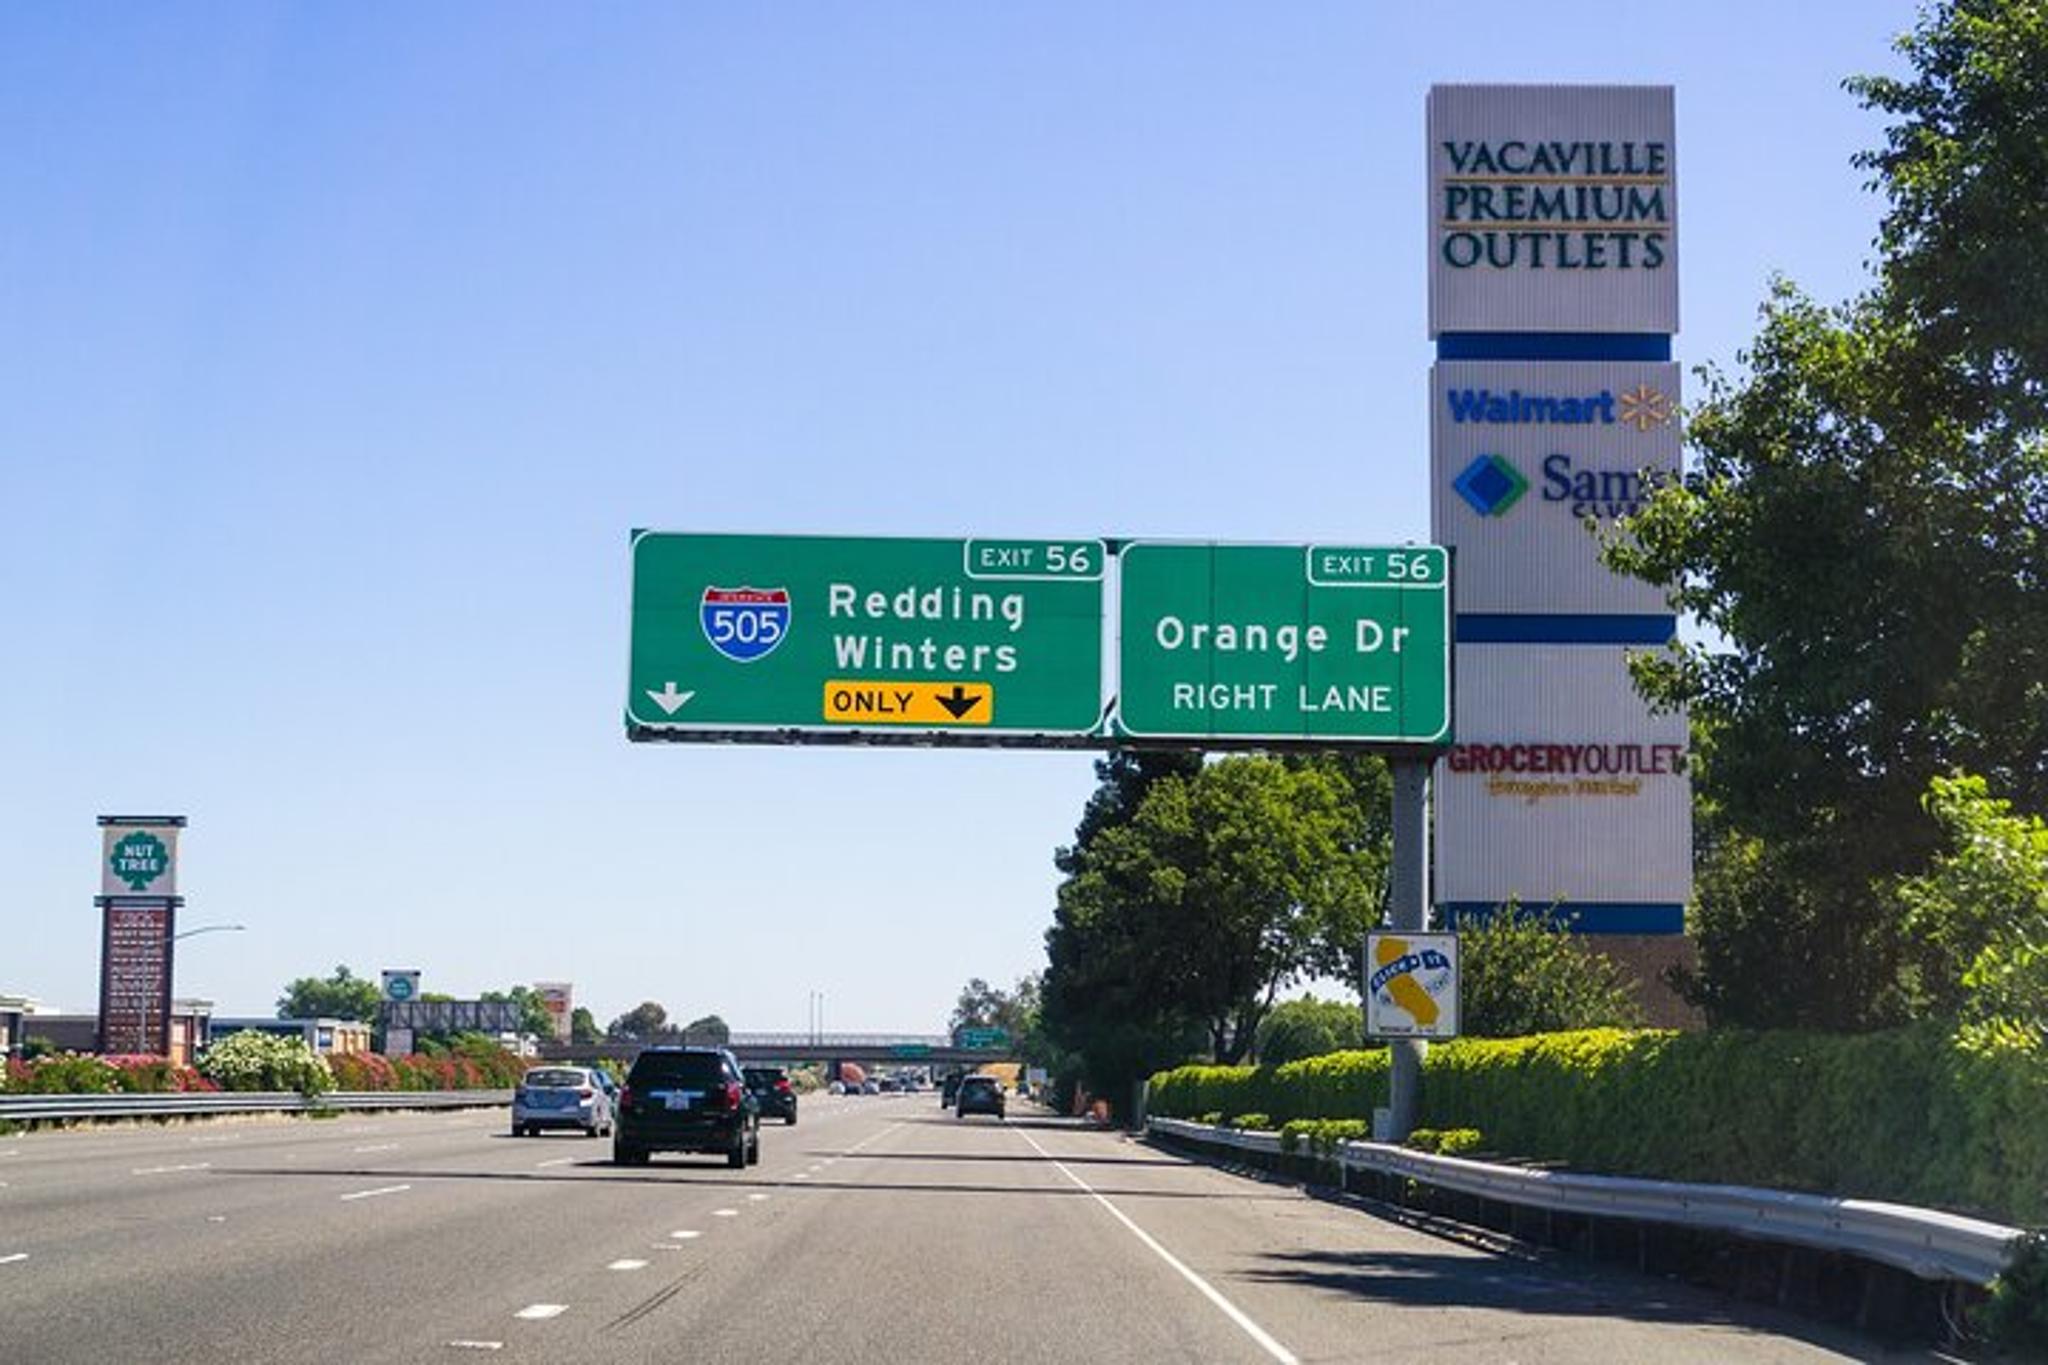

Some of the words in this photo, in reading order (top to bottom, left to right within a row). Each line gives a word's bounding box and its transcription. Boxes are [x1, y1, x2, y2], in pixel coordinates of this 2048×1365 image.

[1443, 141, 1666, 175] VACAVILLE
[1444, 186, 1667, 222] PREMIUM
[1442, 232, 1666, 269] OUTLETS
[1448, 389, 1616, 423] Walmart
[980, 548, 1033, 567] EXIT
[1045, 546, 1090, 572] 56
[1323, 556, 1374, 574] EXIT
[1387, 554, 1431, 579] 56
[829, 584, 1024, 629] Redding
[713, 610, 781, 643] 505
[1156, 616, 1328, 662] Orange
[1356, 619, 1409, 652] Dr
[834, 636, 1018, 672] Winters
[832, 690, 914, 714] ONLY
[1173, 683, 1277, 710] RIGHT
[1299, 686, 1392, 712] LANE
[119, 858, 158, 871] TREE
[124, 844, 154, 857] NUT
